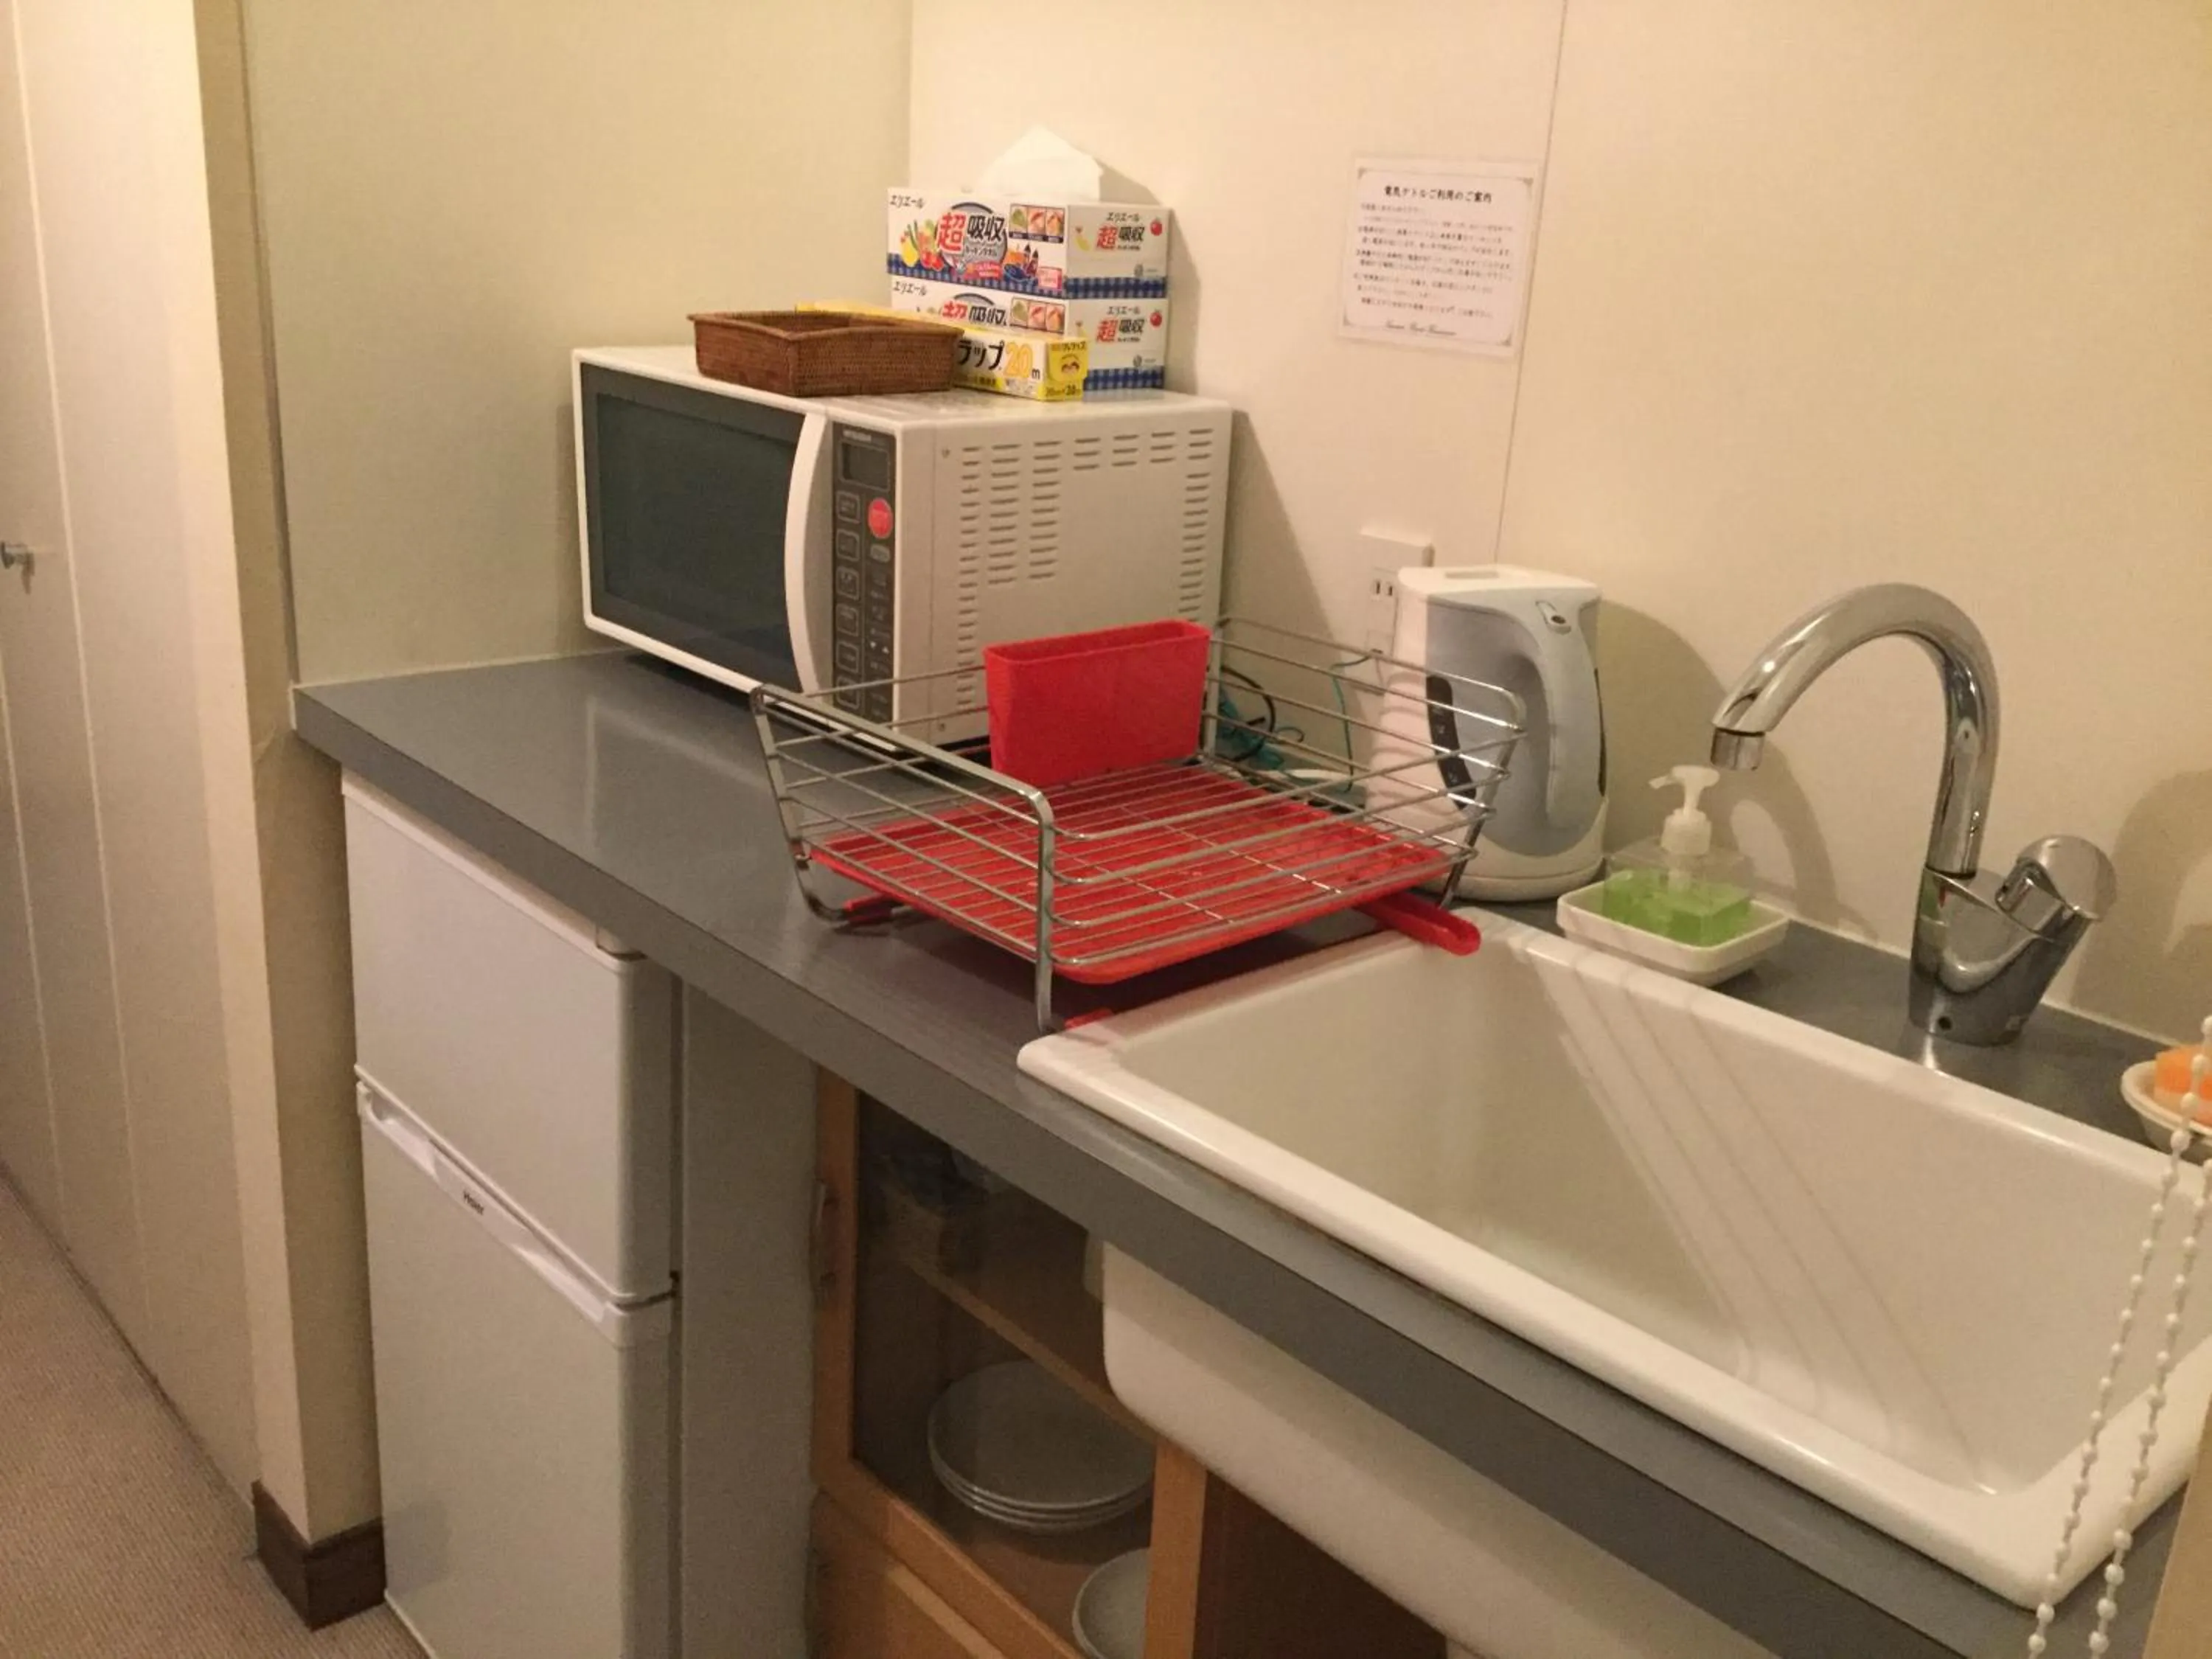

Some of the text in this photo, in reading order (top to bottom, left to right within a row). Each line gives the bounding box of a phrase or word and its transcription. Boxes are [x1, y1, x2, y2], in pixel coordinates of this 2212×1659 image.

[889, 194, 925, 209] エリエール
[939, 212, 1005, 251] 超吸収
[1096, 226, 1145, 250] 超吸収
[893, 280, 927, 296] エリエール
